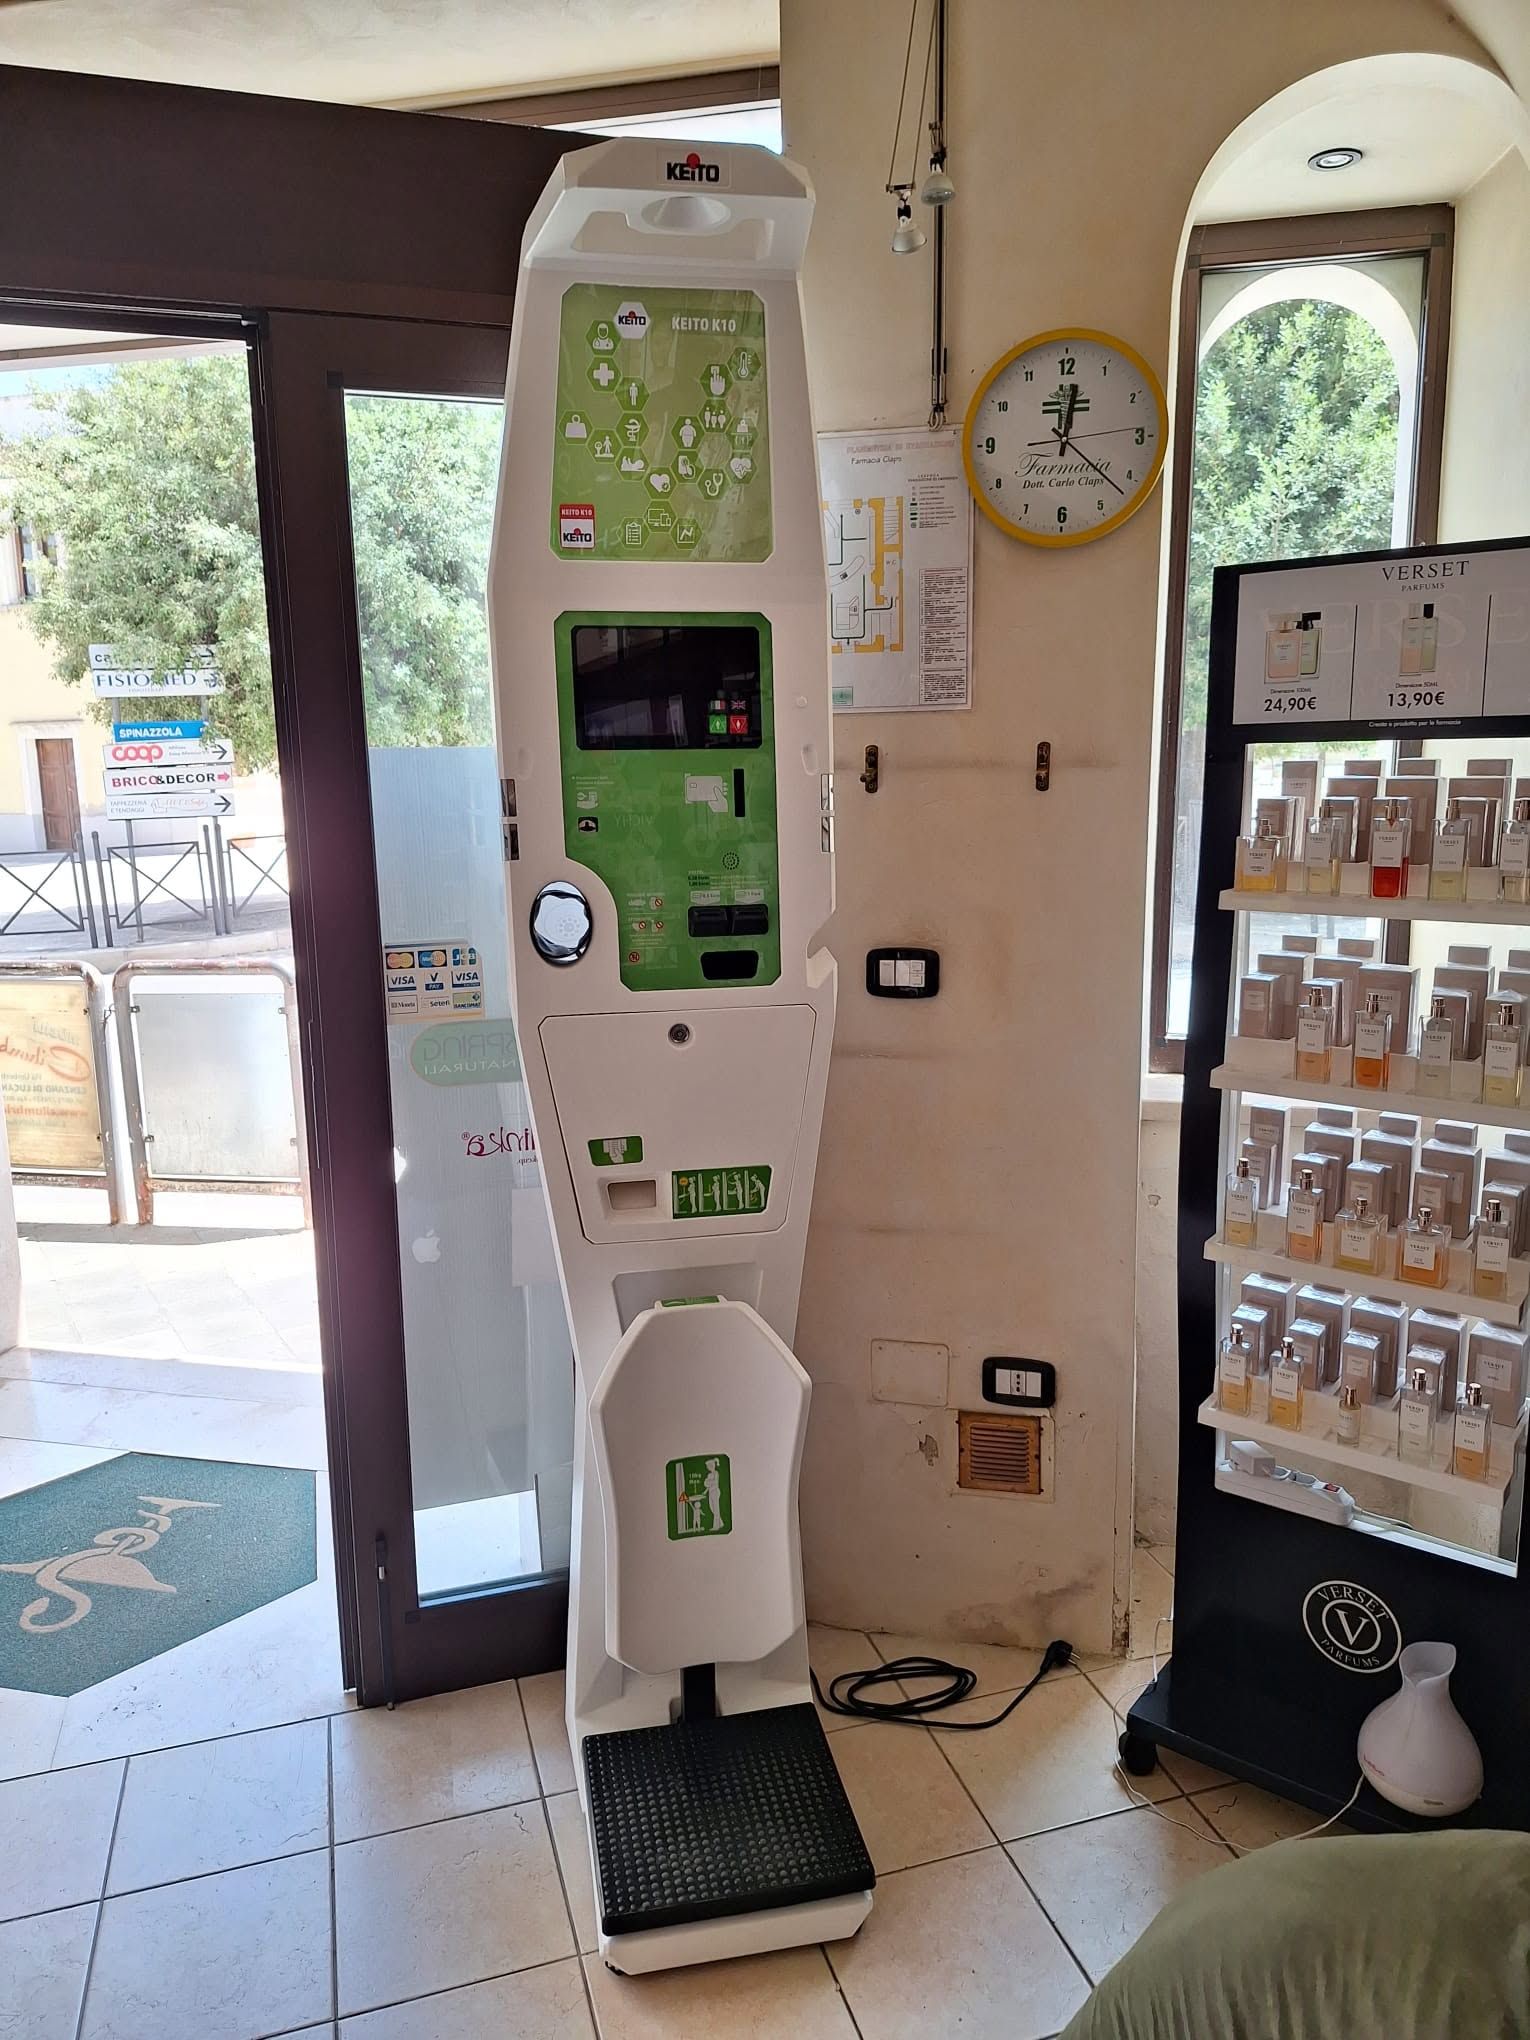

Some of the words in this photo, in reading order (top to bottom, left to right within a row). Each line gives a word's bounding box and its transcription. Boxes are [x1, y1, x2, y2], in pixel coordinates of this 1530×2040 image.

[672, 316, 709, 331] KEITO
[712, 319, 736, 333] K10
[1058, 358, 1076, 375] 12
[1102, 366, 1108, 376] 1
[1024, 371, 1034, 382] 11
[1129, 393, 1136, 404] 2
[997, 401, 1009, 412] 10
[1134, 428, 1145, 445] 3
[985, 437, 995, 454] 9
[1014, 452, 1111, 477] Farmacia
[1126, 470, 1132, 480] 4
[995, 479, 1002, 489] 8
[1022, 479, 1045, 489] Dott.
[1048, 478, 1075, 488] Carlo
[1077, 477, 1105, 488] Claps
[1023, 504, 1029, 515] 7
[1097, 500, 1104, 511] 5
[1057, 506, 1067, 523] 6
[1382, 560, 1470, 581] VERSET
[1401, 582, 1445, 592] PARFUMS
[1264, 696, 1317, 713] 24,90€
[1387, 691, 1445, 709] 13,90€
[119, 727, 183, 738] SPINAZZOLA
[391, 975, 415, 985] VISA
[456, 972, 479, 981] VISA
[1317, 1586, 1389, 1621] VERSET
[1334, 1607, 1370, 1646] V
[1320, 1638, 1380, 1668] PARFUMS
